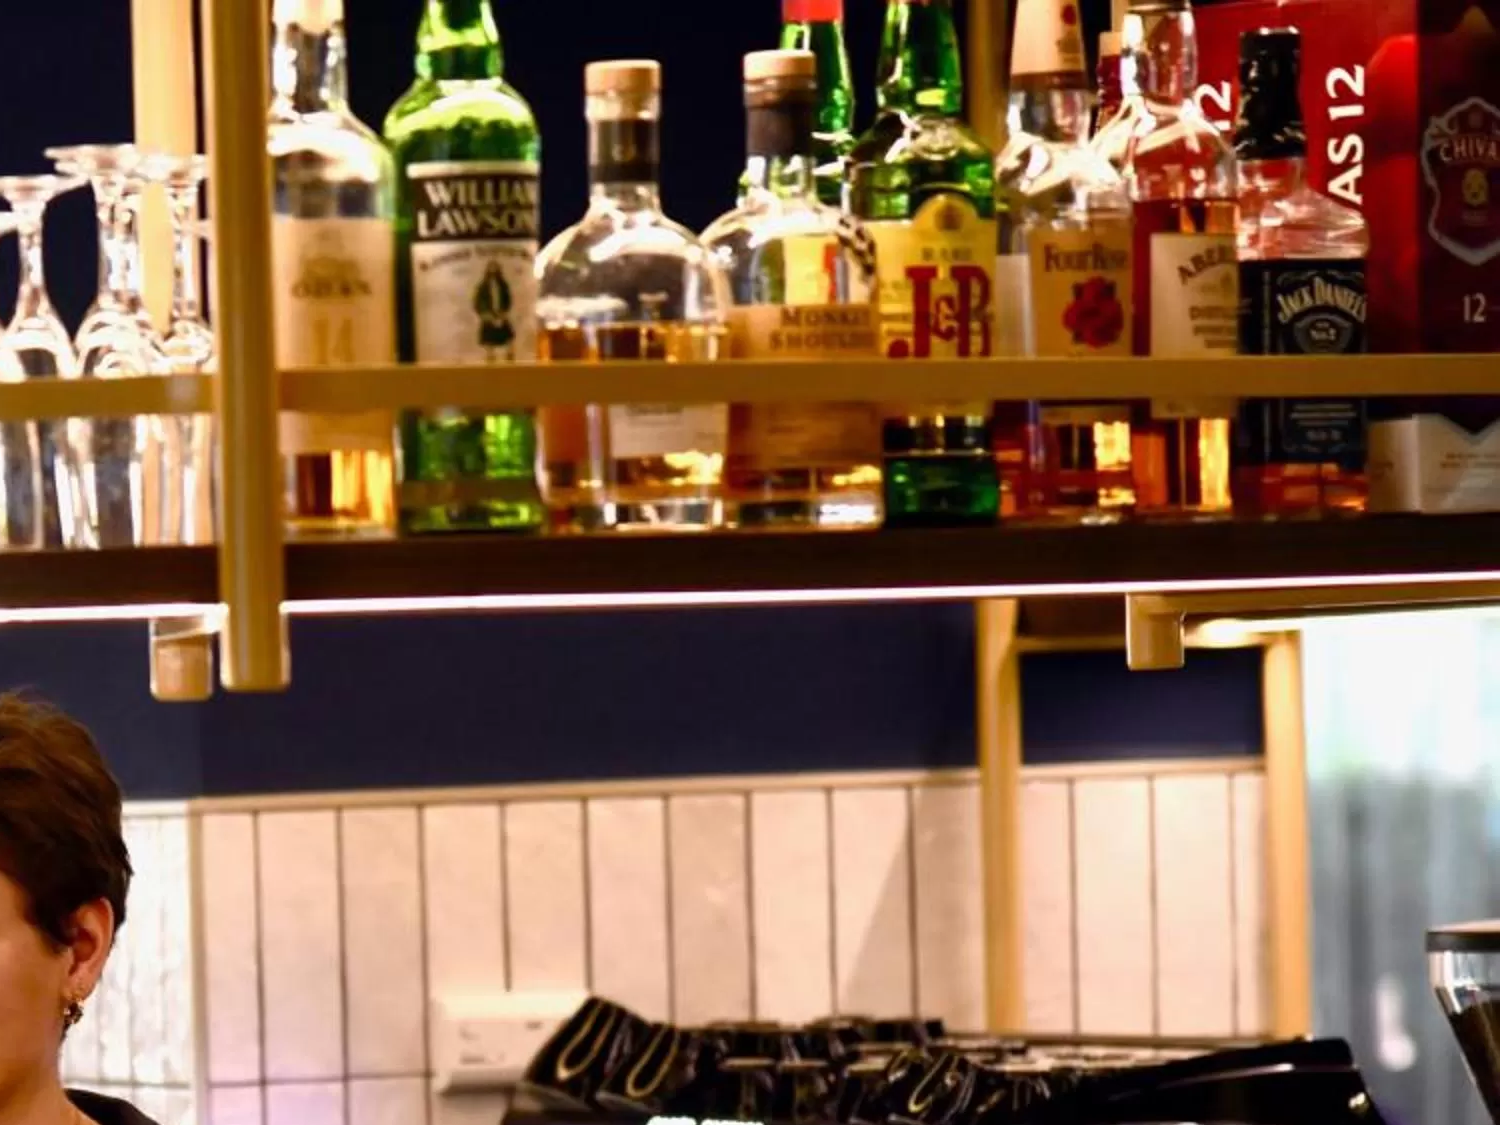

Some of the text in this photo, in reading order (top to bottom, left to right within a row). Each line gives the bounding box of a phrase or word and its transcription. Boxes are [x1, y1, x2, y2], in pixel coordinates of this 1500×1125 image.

[1325, 63, 1365, 121] 12
[1438, 135, 1499, 162] CHIVA
[1462, 292, 1487, 324] 12
